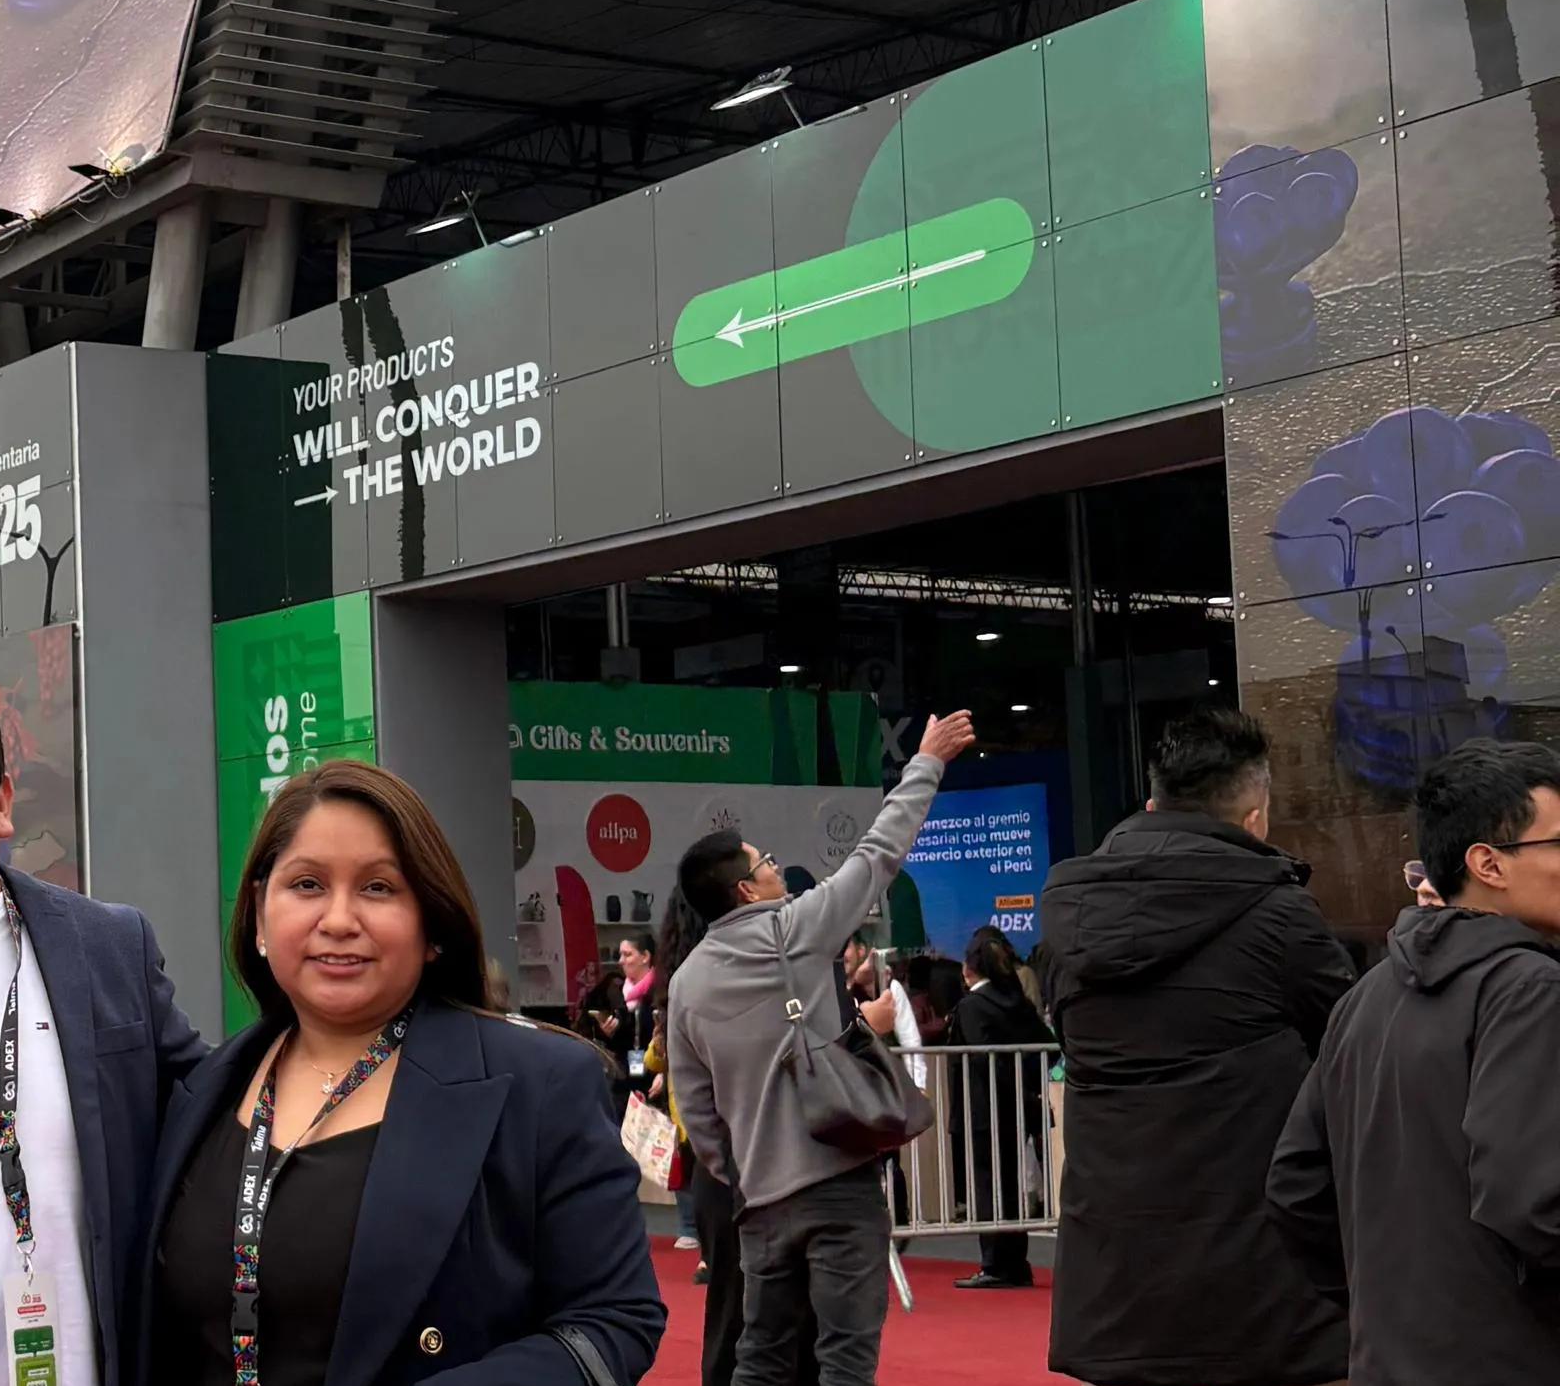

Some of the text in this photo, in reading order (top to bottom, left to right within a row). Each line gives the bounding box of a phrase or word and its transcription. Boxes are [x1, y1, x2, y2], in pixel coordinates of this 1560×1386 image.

[293, 335, 455, 414] YOUR PRODUCTS
[292, 362, 540, 467] WILL CONQUER
[343, 417, 542, 505] THE WORLD
[529, 724, 582, 751] Gifts
[590, 726, 608, 751] &
[614, 726, 730, 754] Souvenirs
[599, 822, 638, 844] allpa
[974, 814, 985, 828] al
[988, 810, 1030, 829] gremio
[962, 833, 986, 845] que
[990, 829, 1031, 842] mueve
[906, 844, 1032, 862] omercio exterior en
[990, 858, 1032, 873] el Perú
[989, 913, 1034, 932] ADEX
[4, 1039, 15, 1072] ADEX
[243, 1174, 257, 1205] ADEX
[257, 1178, 272, 1211] ADEX
